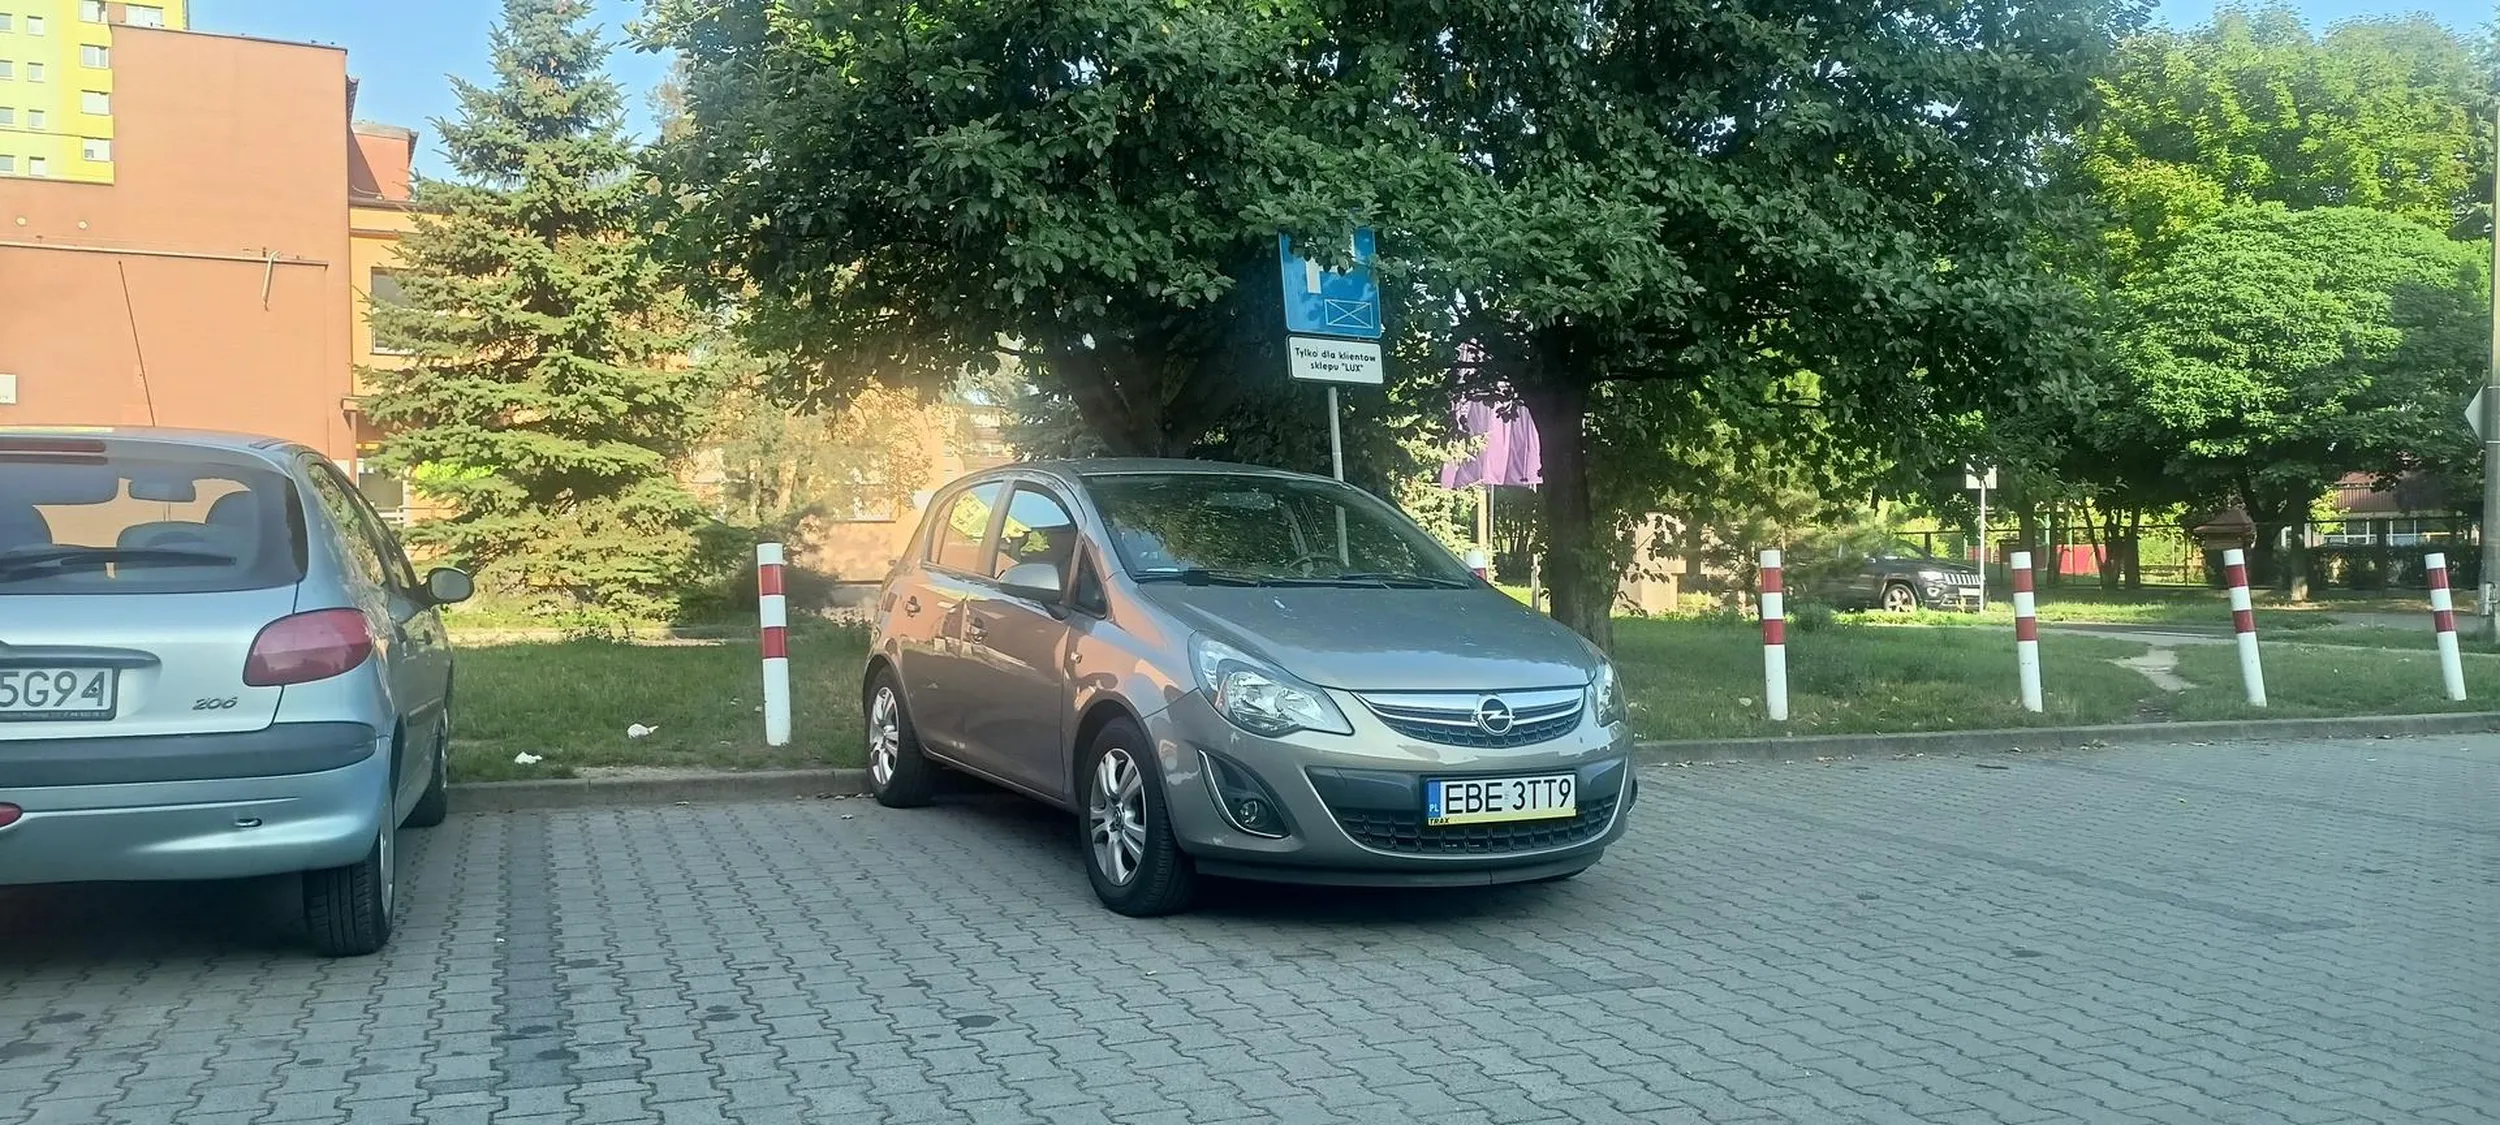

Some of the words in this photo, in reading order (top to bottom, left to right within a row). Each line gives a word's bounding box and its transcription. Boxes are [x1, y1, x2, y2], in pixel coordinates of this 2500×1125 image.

[1295, 347, 1318, 358] Tylko
[1321, 350, 1335, 359] dla
[1310, 361, 1339, 372] sklepu
[1341, 362, 1364, 372] "LUX"
[0, 670, 105, 708] 5G94
[191, 696, 238, 711] 206
[1445, 782, 1503, 815] EBE
[1512, 778, 1572, 811] 3TT9
[1429, 803, 1439, 812] PL
